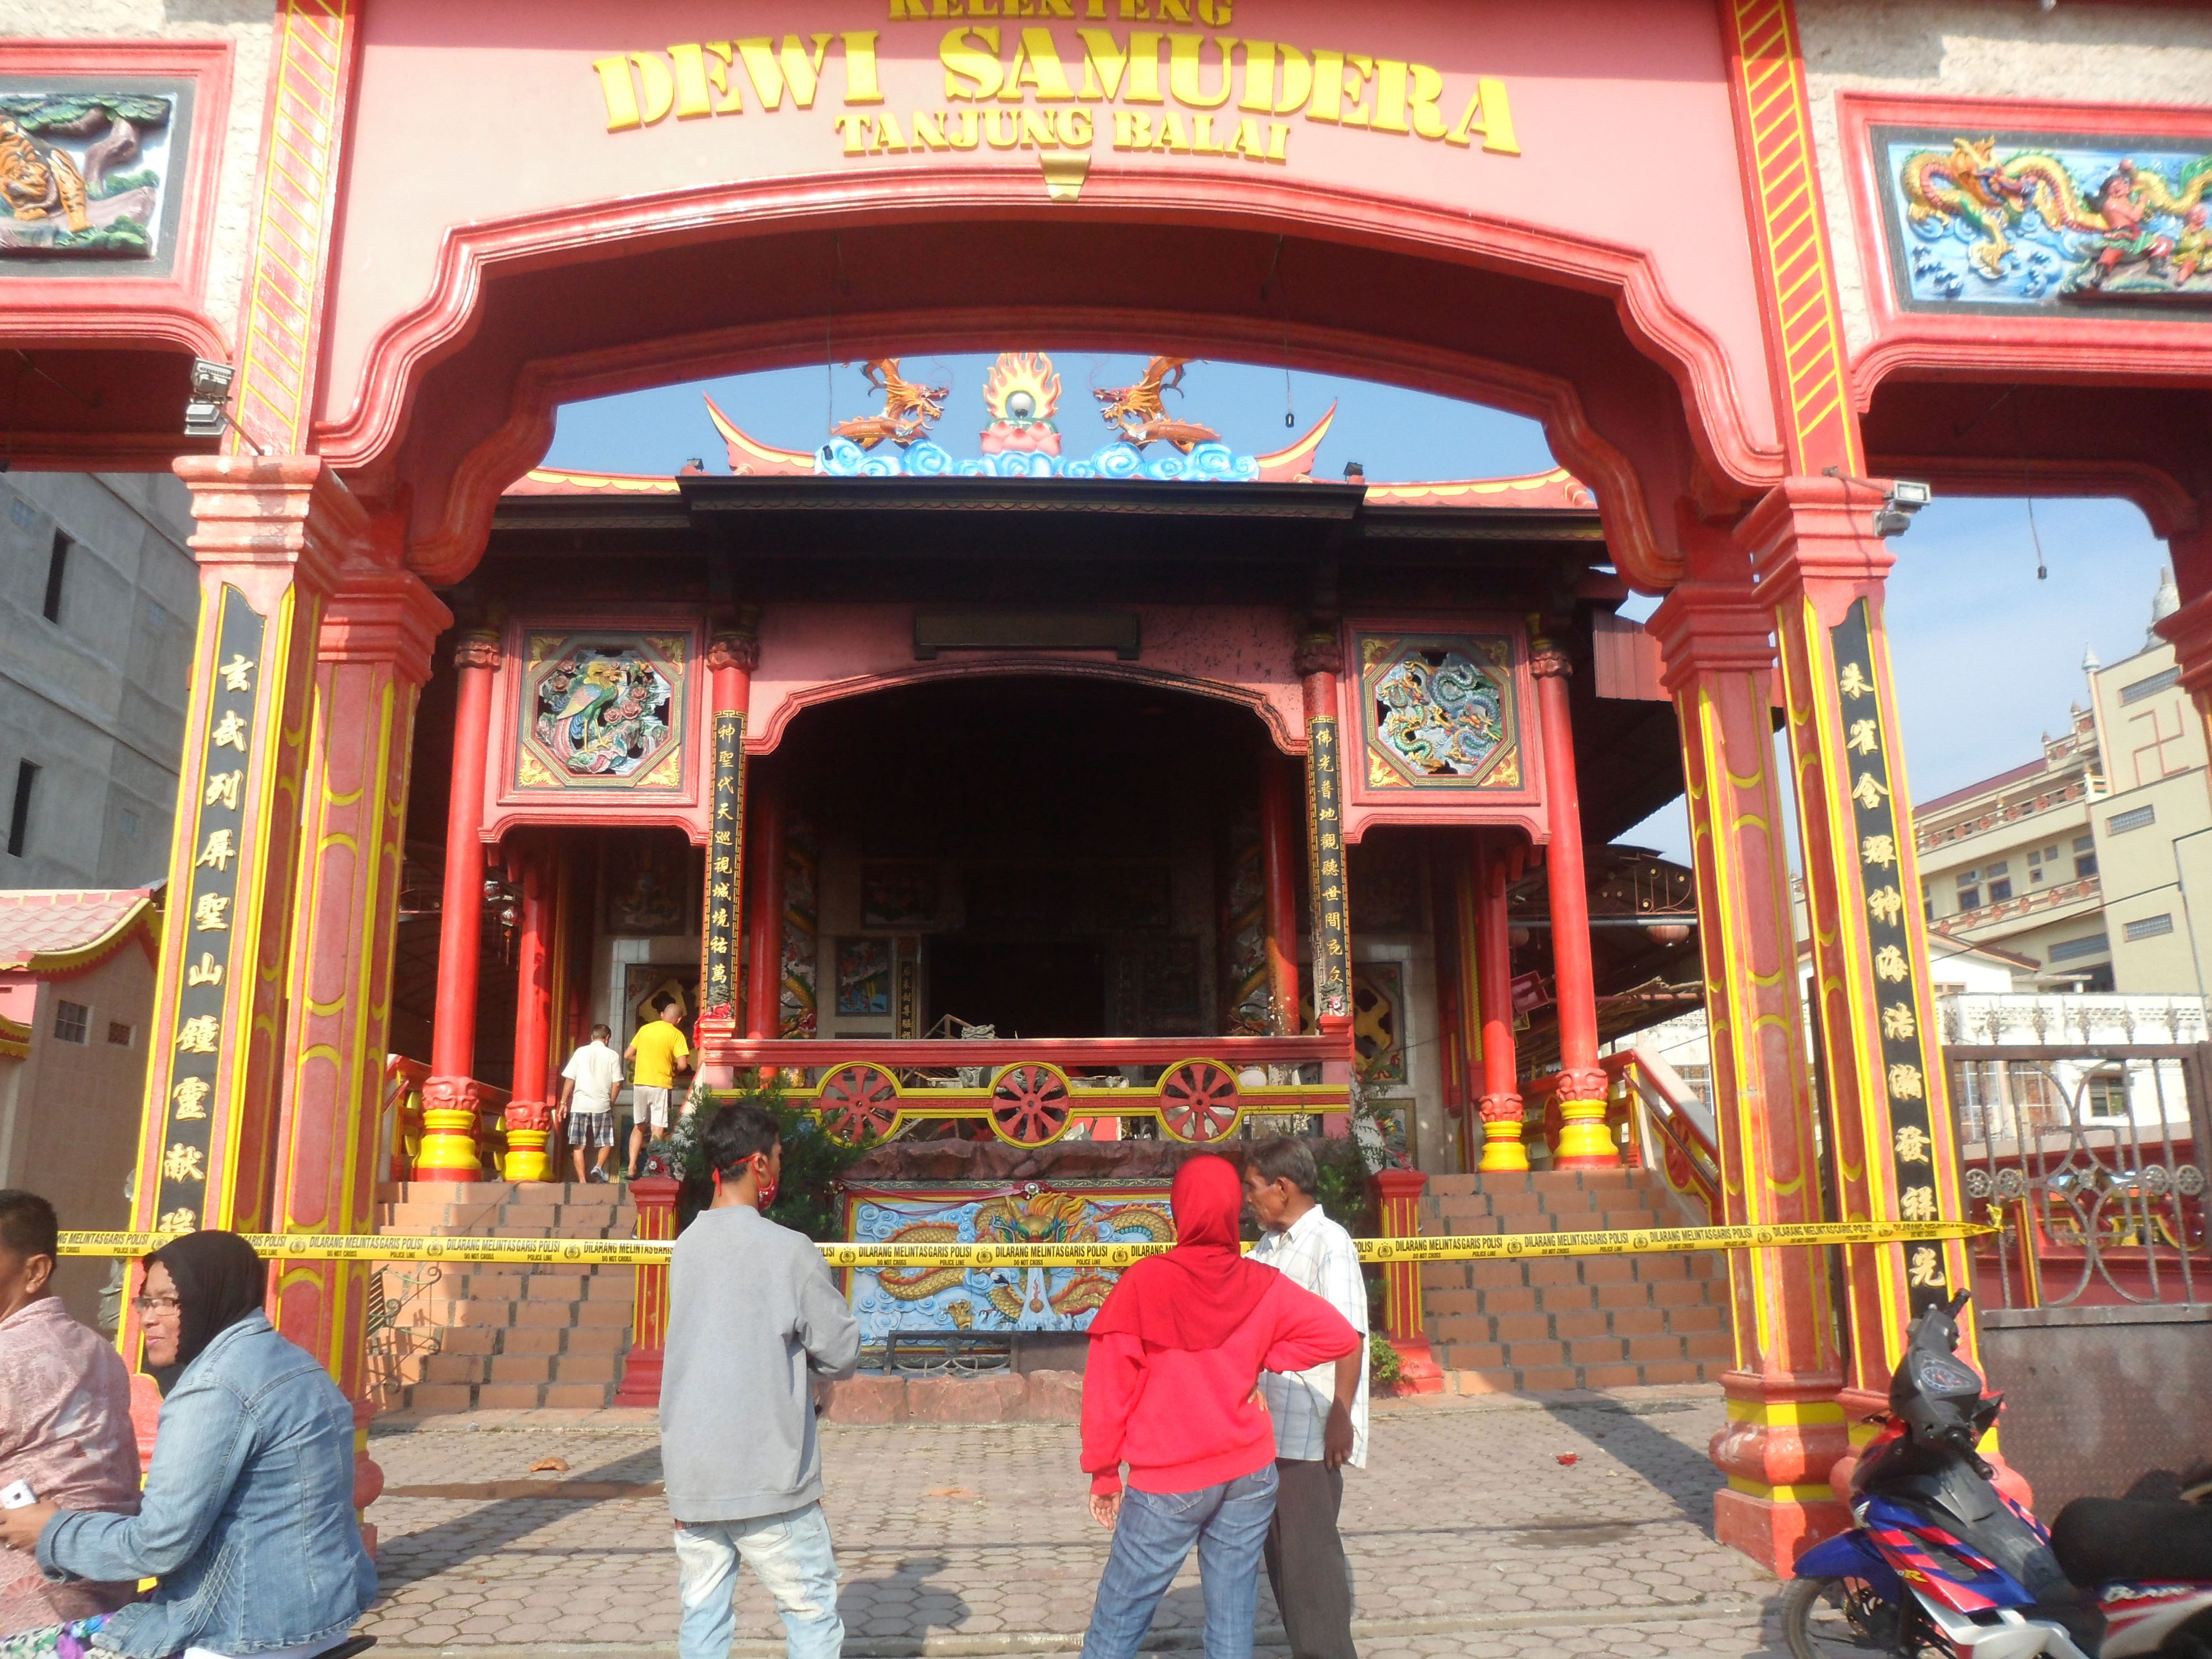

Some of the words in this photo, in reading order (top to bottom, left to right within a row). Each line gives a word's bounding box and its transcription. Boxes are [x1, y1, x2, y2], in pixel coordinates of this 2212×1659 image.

[591, 30, 885, 132] DEWI
[939, 25, 1522, 157] SAMUDERA
[834, 106, 1094, 156] TANJUNG
[1112, 109, 1290, 163] BALAI
[126, 1234, 149, 1245] POLISI
[264, 1235, 286, 1246] POLISI
[1525, 1235, 1556, 1247] DILARANG
[1557, 1234, 1588, 1246] MELINTAS
[1588, 1233, 1607, 1244] GARIS
[1609, 1232, 1629, 1244] POLISI
[1650, 1230, 1681, 1242] DILARANG
[1682, 1229, 1713, 1241] MELINTAS
[1713, 1229, 1731, 1240] GARIS
[1733, 1228, 1752, 1239] POLISI
[309, 1236, 343, 1248] DILARANG
[345, 1237, 379, 1248] MELINTAS
[380, 1237, 400, 1249] GARIS
[402, 1238, 423, 1249] POLISI
[447, 1239, 479, 1251] DILARANG
[482, 1239, 515, 1251] MELINTAS
[517, 1240, 536, 1252] GARIS
[539, 1241, 560, 1252] POLISI
[584, 1241, 617, 1254] DILARANG
[619, 1243, 653, 1254] MELINTAS
[1396, 1239, 1427, 1251] DILARANG
[1430, 1238, 1461, 1250] MELINTAS
[1461, 1238, 1481, 1249] GARIS
[1482, 1237, 1502, 1248] POLISI
[859, 1246, 892, 1258] DILARANG
[894, 1246, 928, 1258] MELINTAS
[928, 1246, 948, 1258] GARIS
[951, 1246, 972, 1258] POLISI
[995, 1246, 1028, 1257] DILARANG
[1031, 1246, 1065, 1257] MELINTAS
[1065, 1246, 1085, 1257] GARIS
[1087, 1245, 1108, 1257] POLISI
